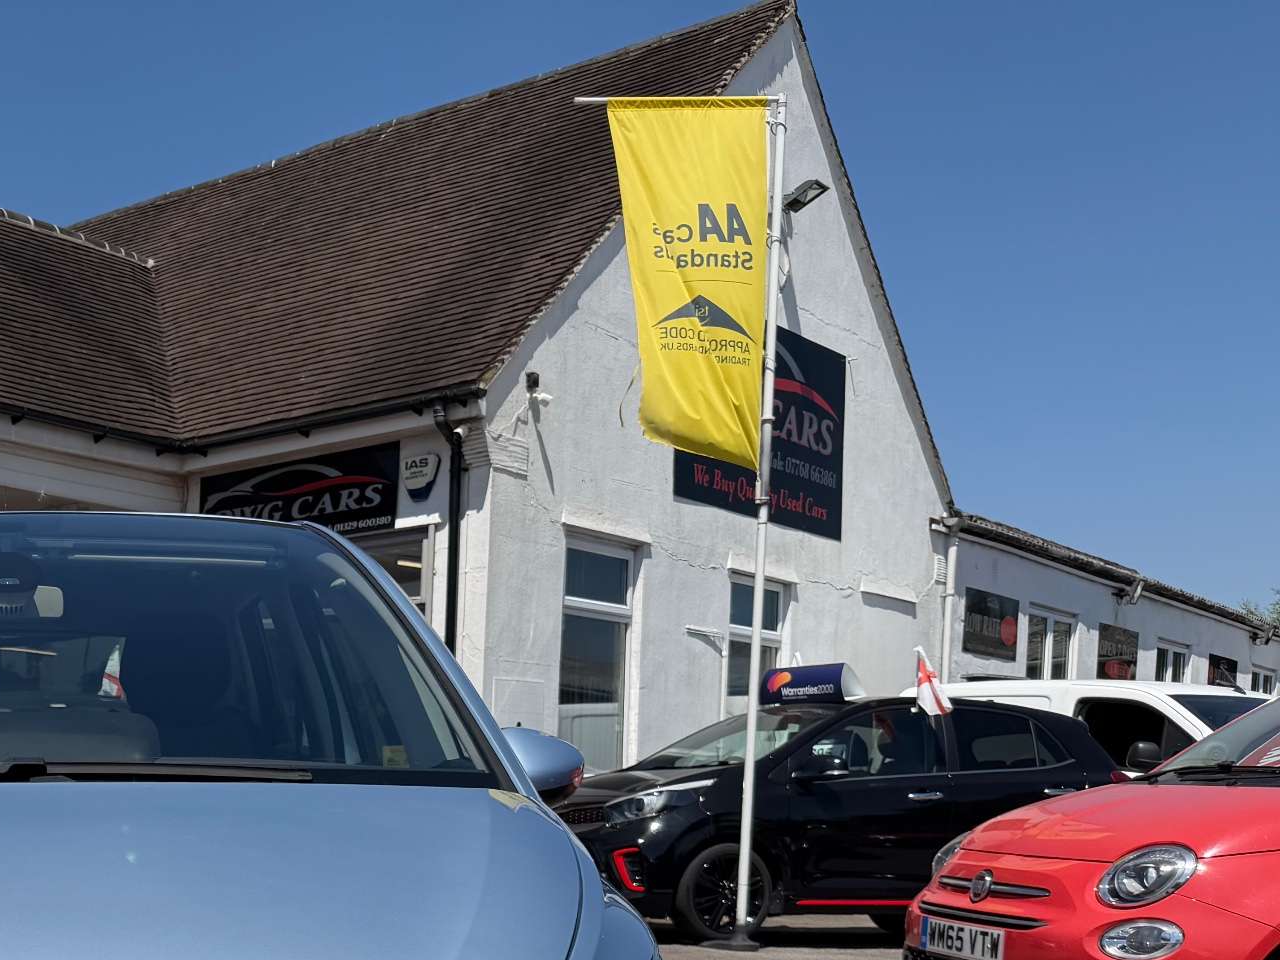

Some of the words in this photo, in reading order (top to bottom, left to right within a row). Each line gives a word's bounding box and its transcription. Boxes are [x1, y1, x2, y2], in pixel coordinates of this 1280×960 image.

[405, 458, 429, 471] IAS
[785, 457, 809, 480] 07768
[291, 484, 384, 519] CARS
[694, 463, 710, 487] We
[713, 469, 736, 502] Buy
[780, 488, 804, 513] Used
[805, 497, 829, 521] Cars
[928, 920, 964, 952] WM65
[970, 929, 1000, 960] VTW
